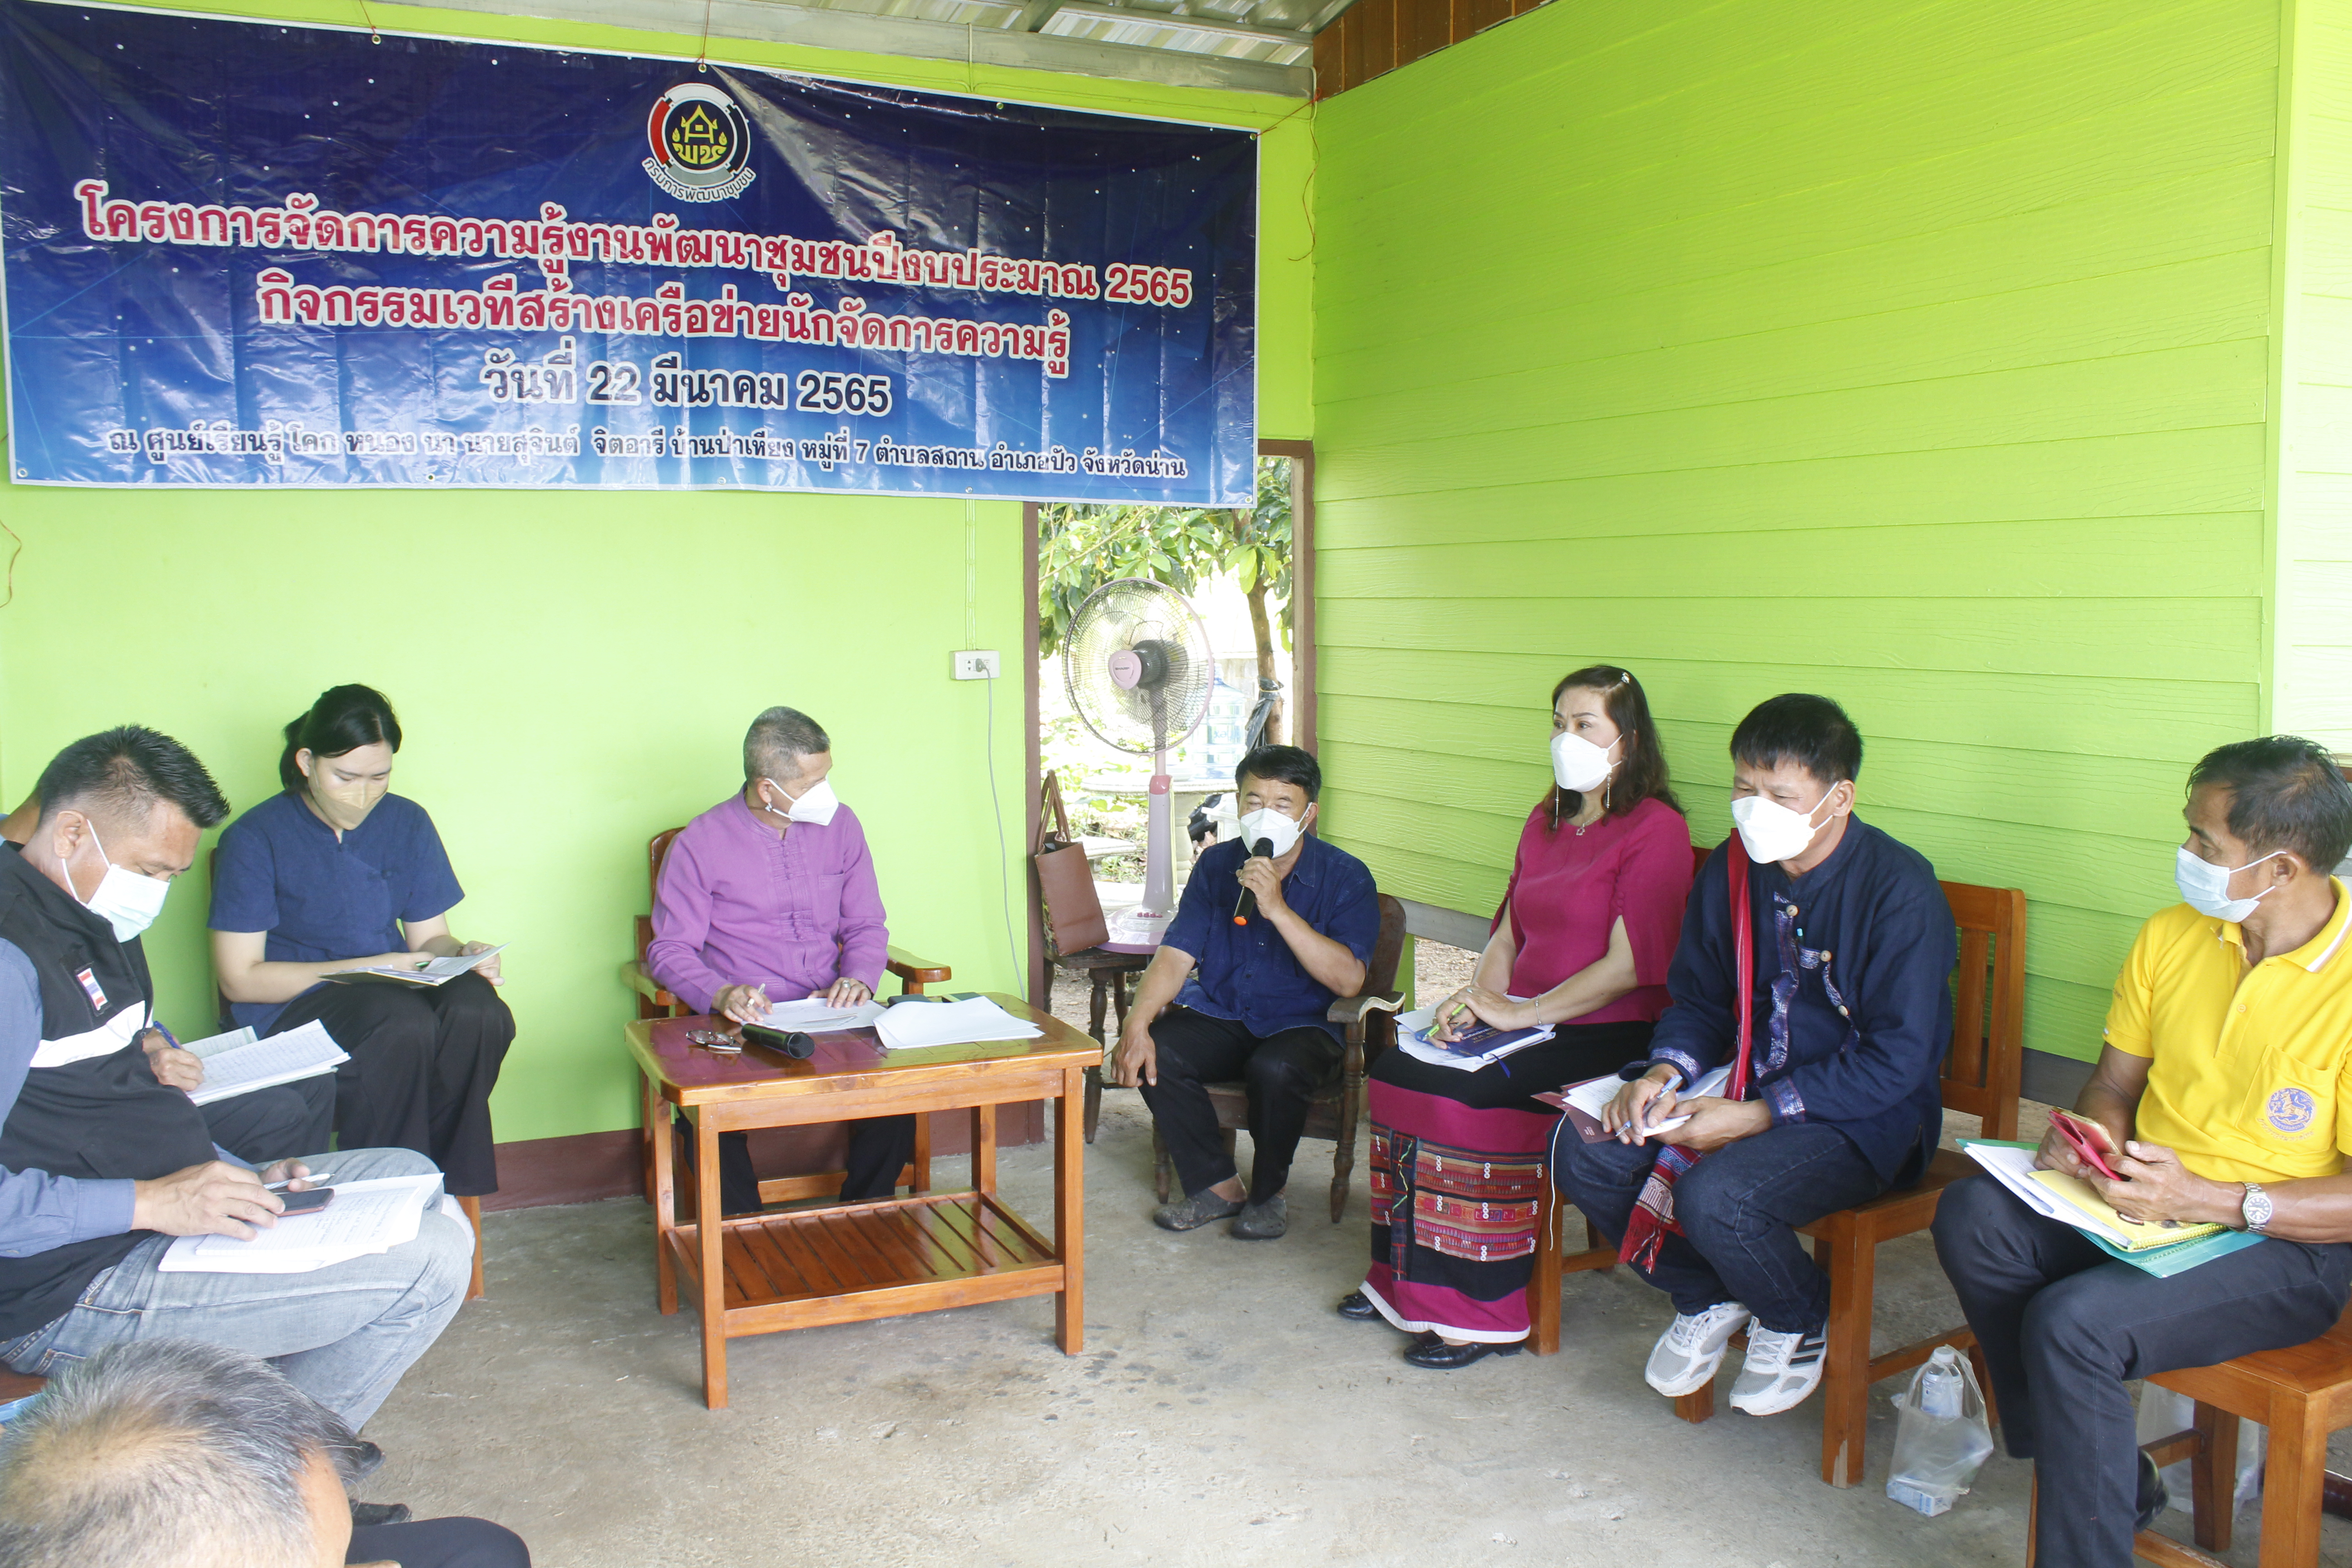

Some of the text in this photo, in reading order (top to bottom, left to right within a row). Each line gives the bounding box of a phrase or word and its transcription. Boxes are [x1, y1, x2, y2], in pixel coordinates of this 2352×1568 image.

[642, 158, 755, 201] กรมการพัฒนาชุมชน
[79, 182, 1190, 304] โครงการจัดการความรู้งานพัฒนาชุมชนปีงบประมาณ 2565
[260, 272, 1068, 374] กิจกรรมเวทีสร้างเครือข่ายนักจัดการความรู้
[484, 340, 889, 412] วันที่ 22 มีนาคม 2565
[109, 431, 137, 451] ณ
[288, 423, 337, 451] โคก
[346, 434, 415, 452] หนอง
[425, 434, 454, 452] นา
[465, 426, 579, 463] นายสุจินต์
[593, 428, 664, 455] จิตอารี
[802, 429, 848, 470] หมู่ที่
[856, 442, 868, 461] 7
[876, 438, 985, 467] ตำบลสถาน
[992, 445, 1076, 470] อำเภอปัว
[1083, 447, 1186, 476] จังหวัดน่าน
